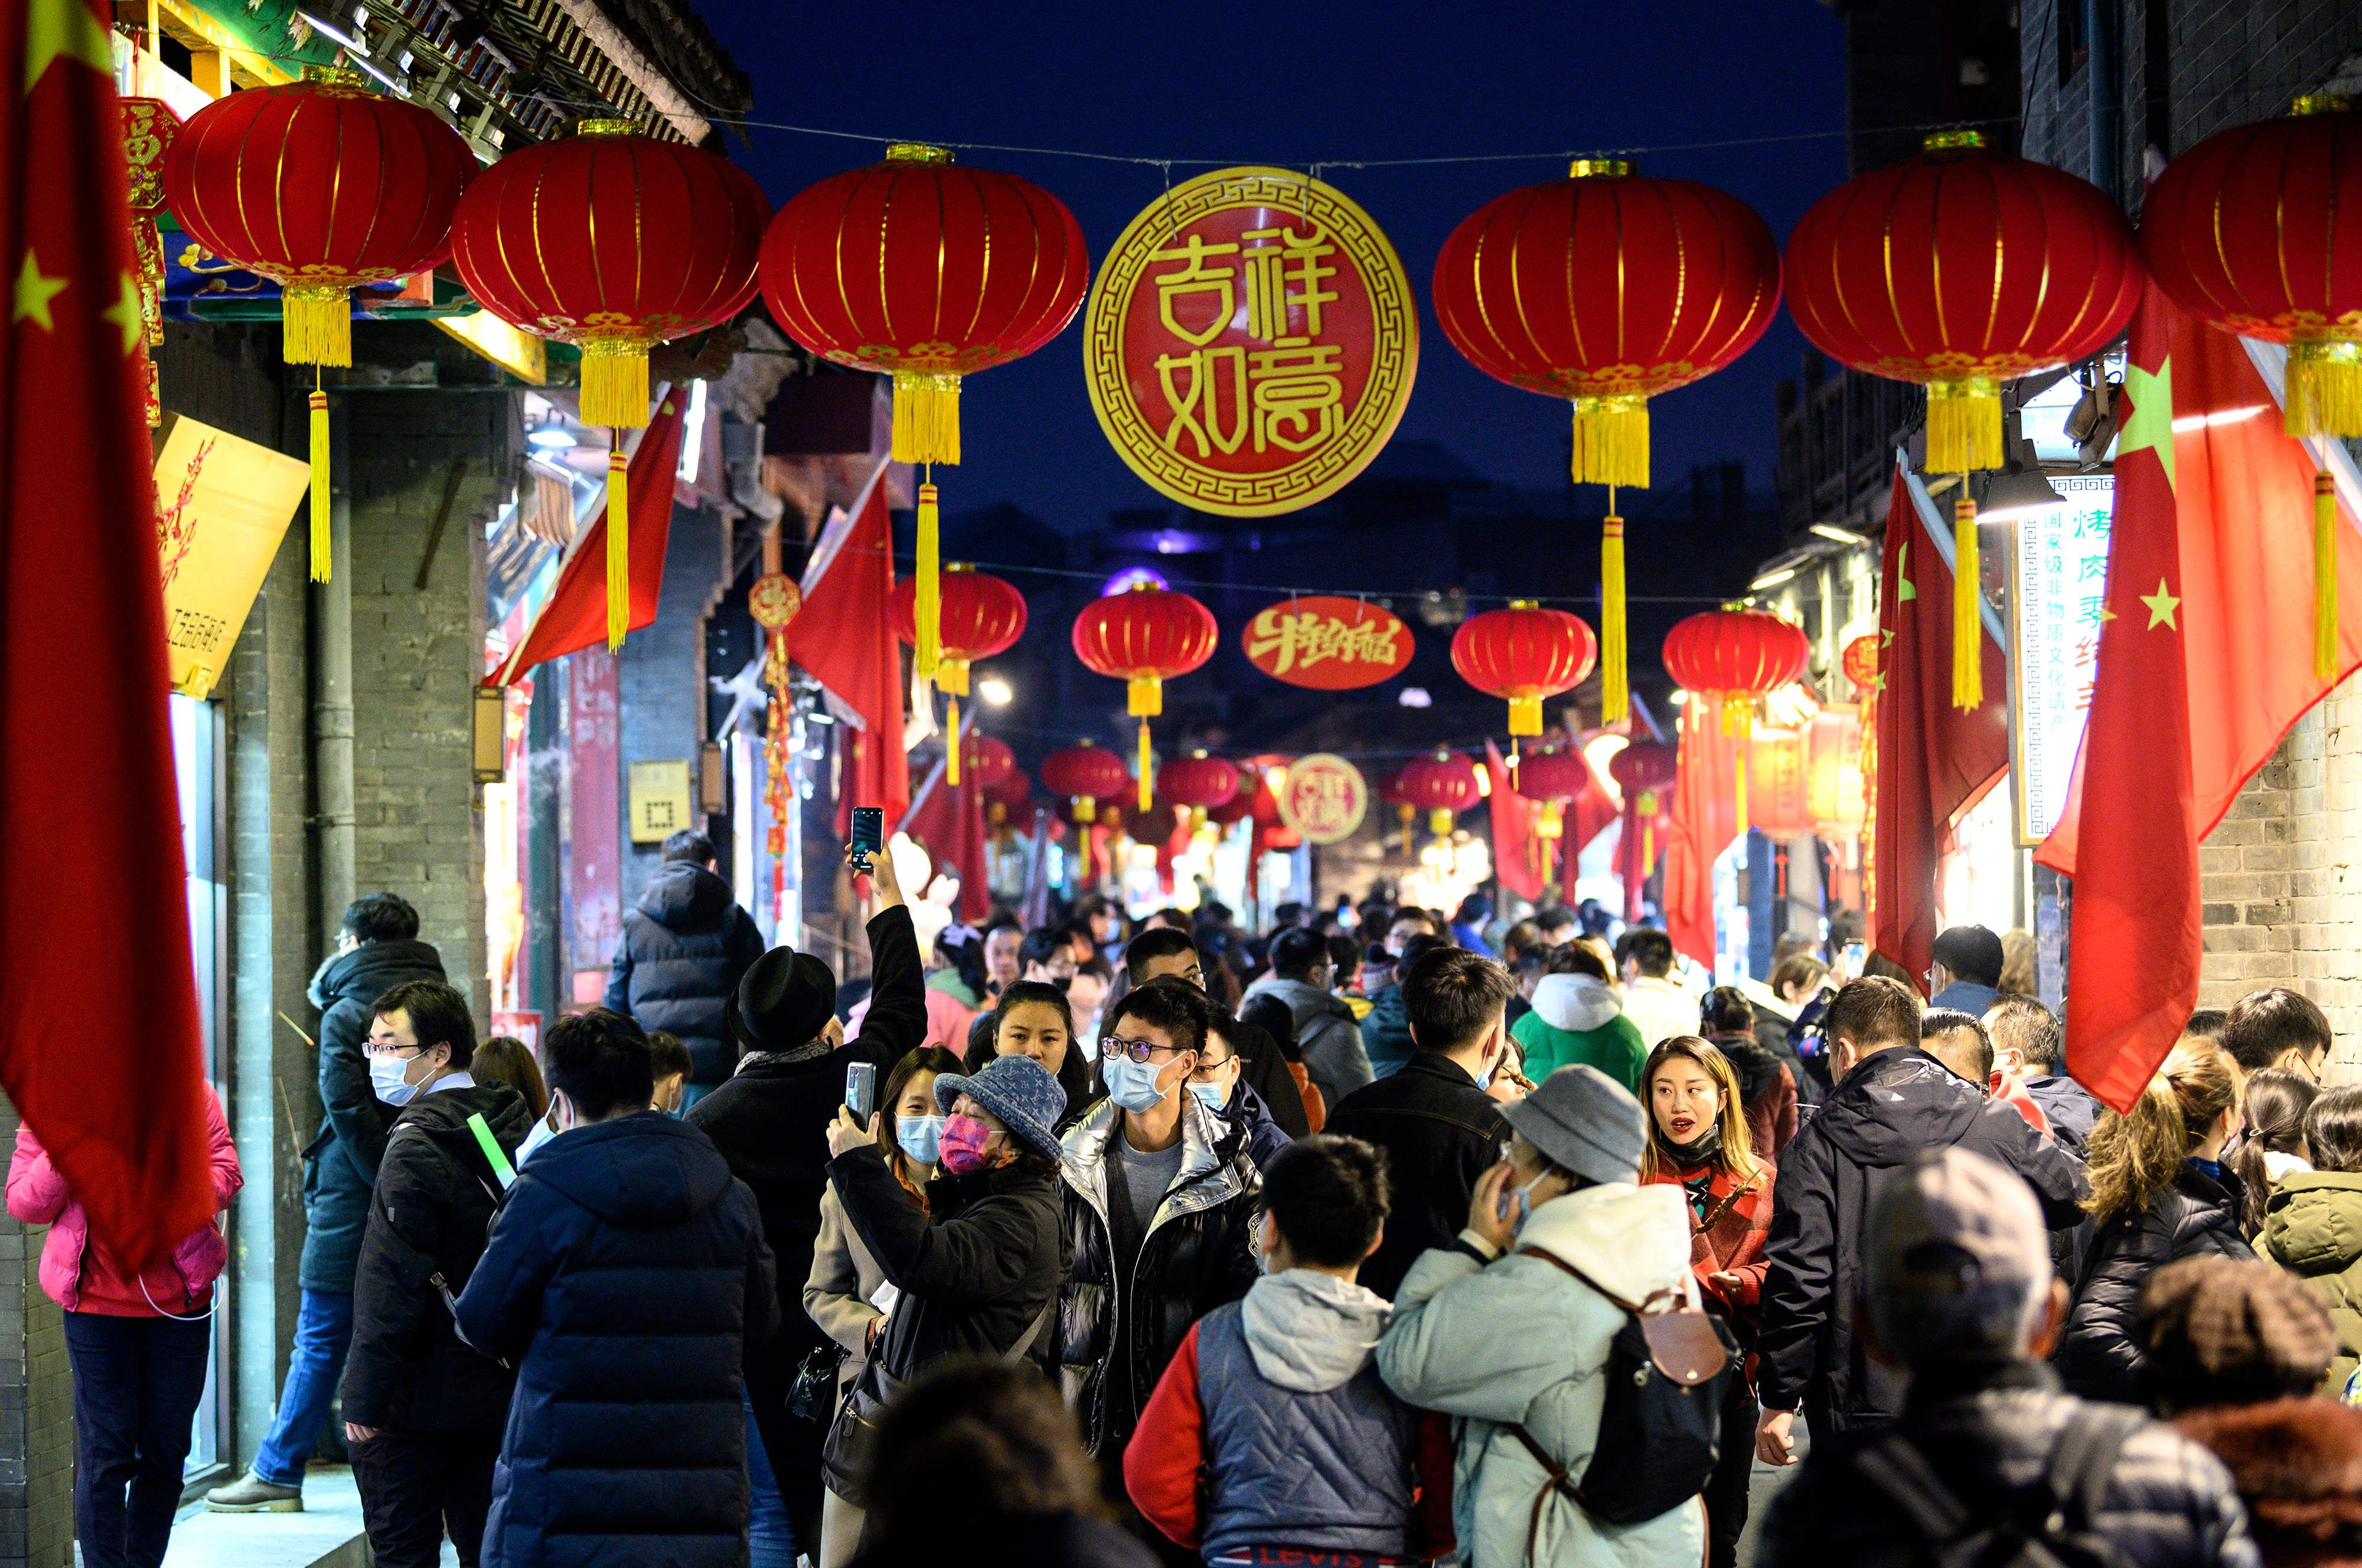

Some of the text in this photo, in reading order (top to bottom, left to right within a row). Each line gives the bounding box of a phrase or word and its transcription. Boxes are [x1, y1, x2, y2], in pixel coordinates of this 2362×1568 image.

[1149, 226, 1339, 346] 吉祥
[1153, 337, 1345, 458] 如意
[2044, 510, 2066, 732] 国家级非物质文化遗产
